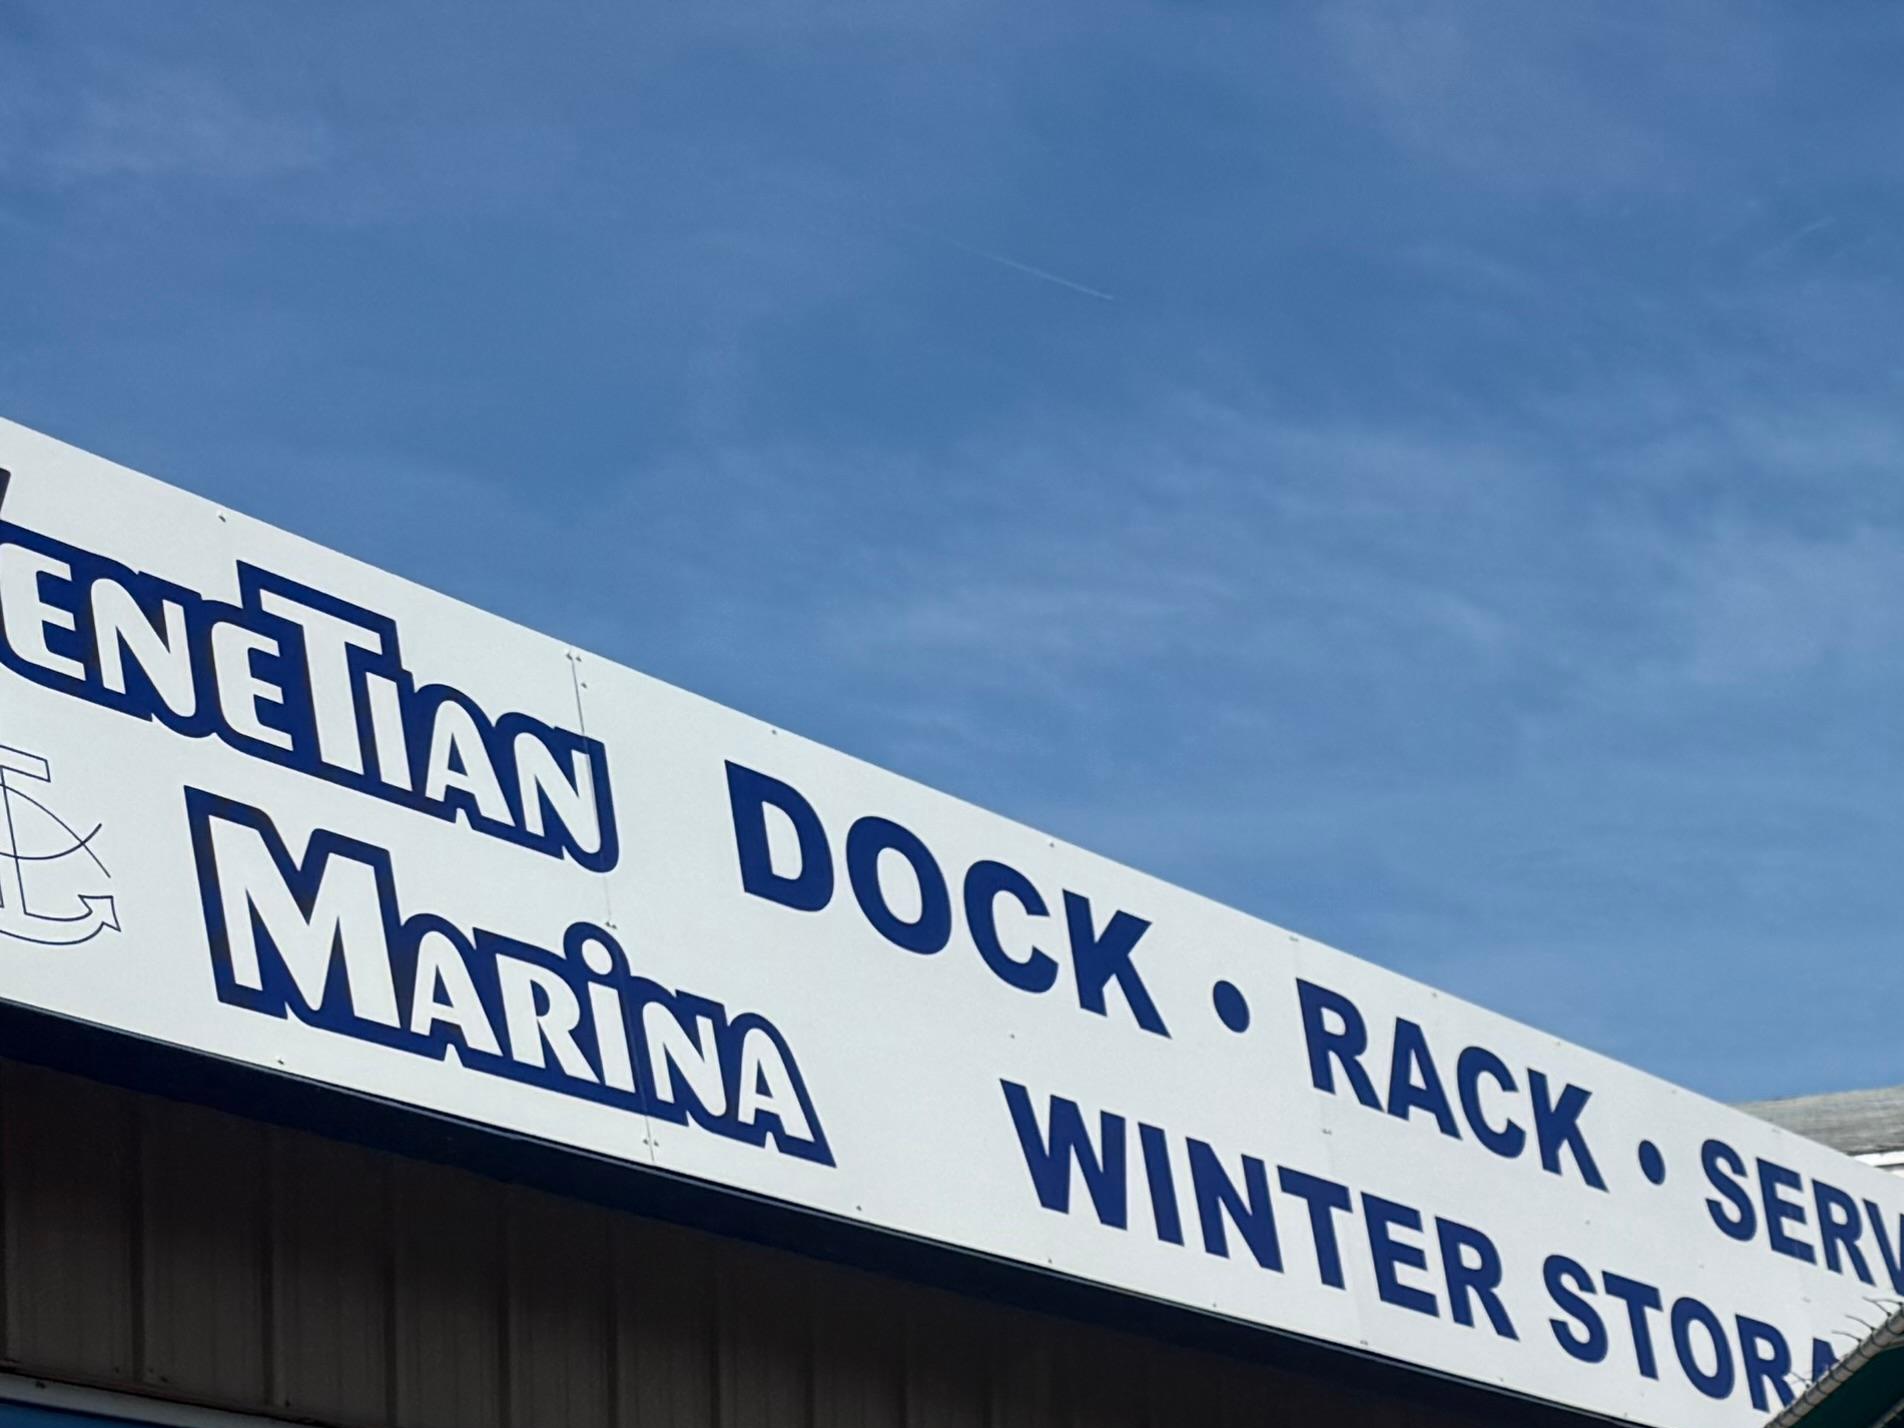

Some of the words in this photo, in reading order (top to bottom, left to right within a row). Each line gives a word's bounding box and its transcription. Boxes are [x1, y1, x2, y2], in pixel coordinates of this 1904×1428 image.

[0, 467, 619, 872] ENETIAN
[725, 760, 1171, 1039] DOCK
[1295, 977, 1610, 1193] RACK
[1000, 1078, 1519, 1342] WINTER
[1542, 1254, 1839, 1413] STOR
